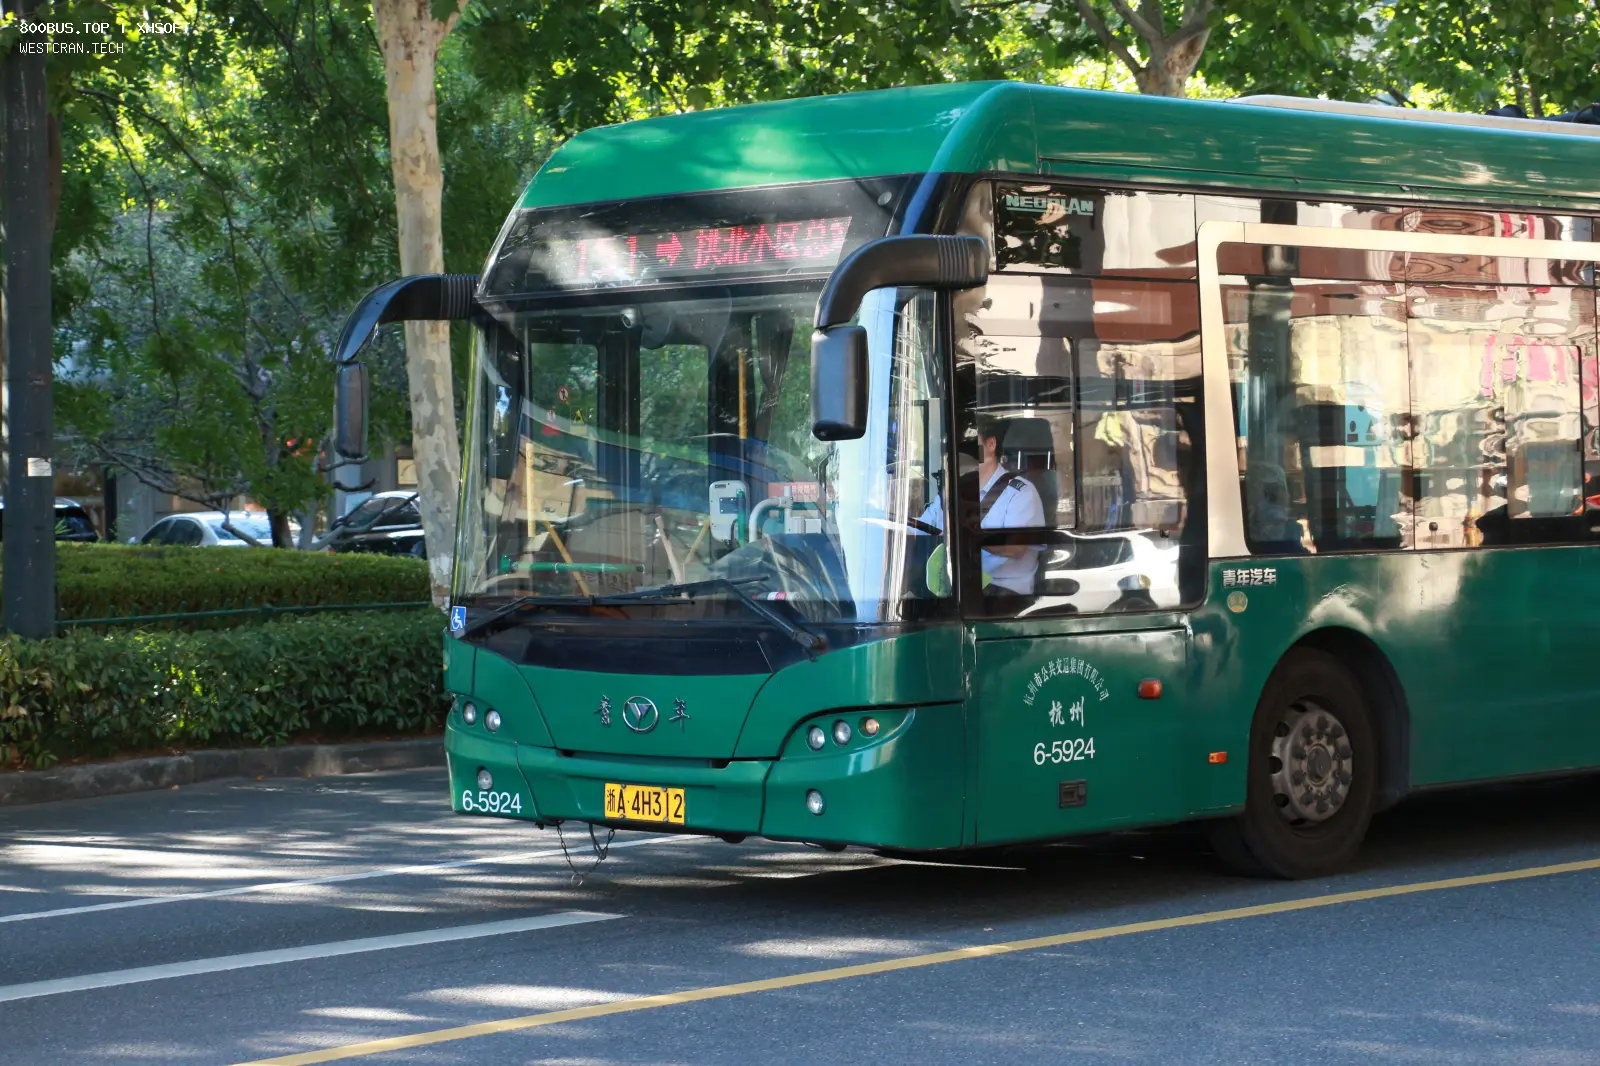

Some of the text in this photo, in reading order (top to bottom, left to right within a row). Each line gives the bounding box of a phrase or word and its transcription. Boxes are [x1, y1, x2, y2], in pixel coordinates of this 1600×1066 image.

[1222, 567, 1277, 587] 青年汽车
[1022, 657, 1110, 706] 杭州市公共交通集团有限公司
[1048, 695, 1085, 728] 杭州
[1033, 737, 1096, 766] 6-5924
[462, 789, 522, 814] 6-5924
